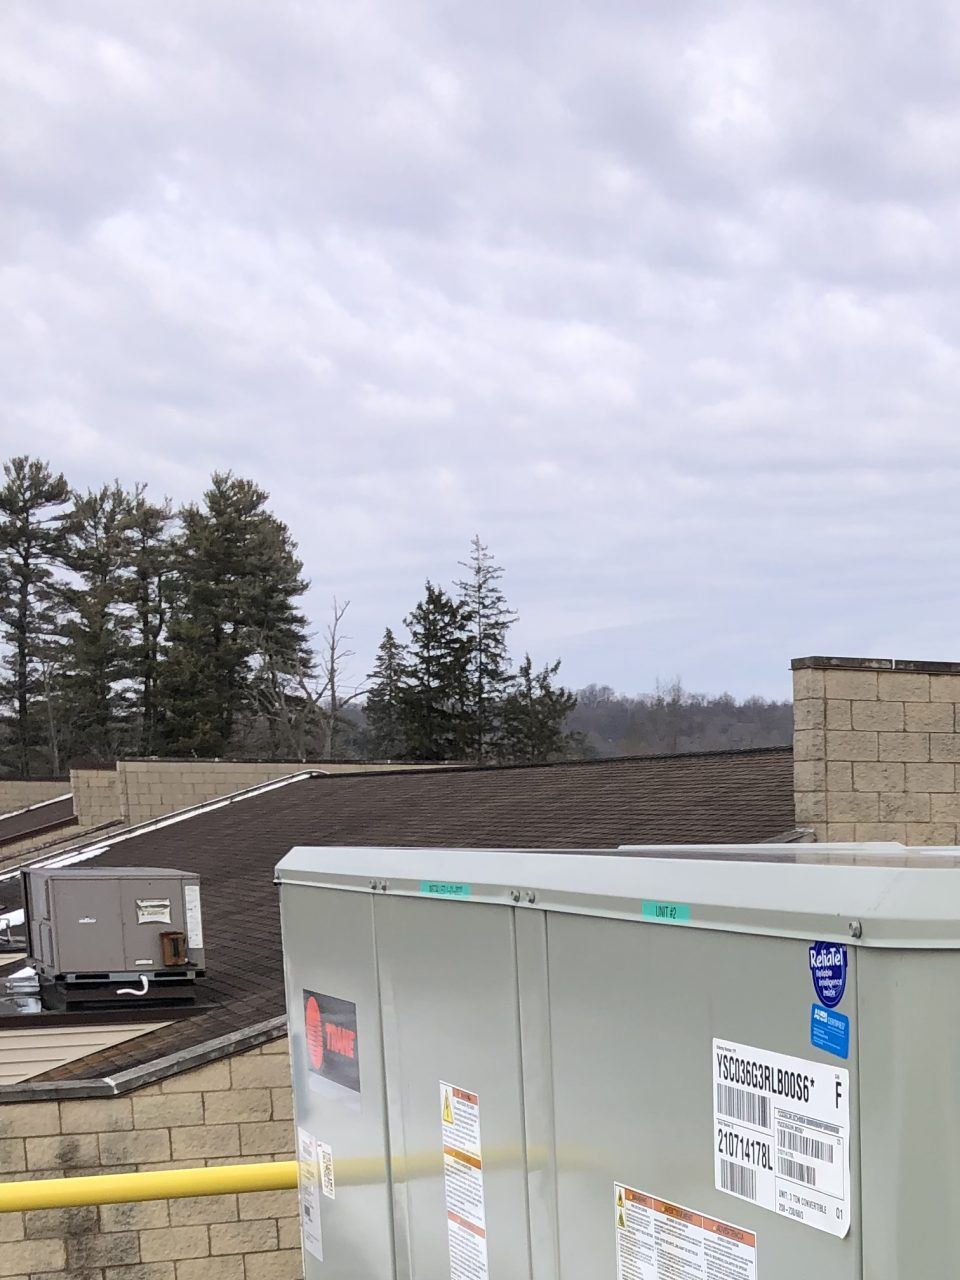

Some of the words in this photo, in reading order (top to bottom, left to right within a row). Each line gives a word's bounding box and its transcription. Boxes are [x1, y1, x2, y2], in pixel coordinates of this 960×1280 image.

[656, 905, 668, 918] UNIT
[810, 947, 843, 968] ReliaTel
[816, 969, 833, 978] Reliable
[818, 978, 842, 988] Intelligence
[326, 1023, 356, 1058] TRANE
[835, 1081, 842, 1109] F
[717, 1128, 773, 1171] 210714178L
